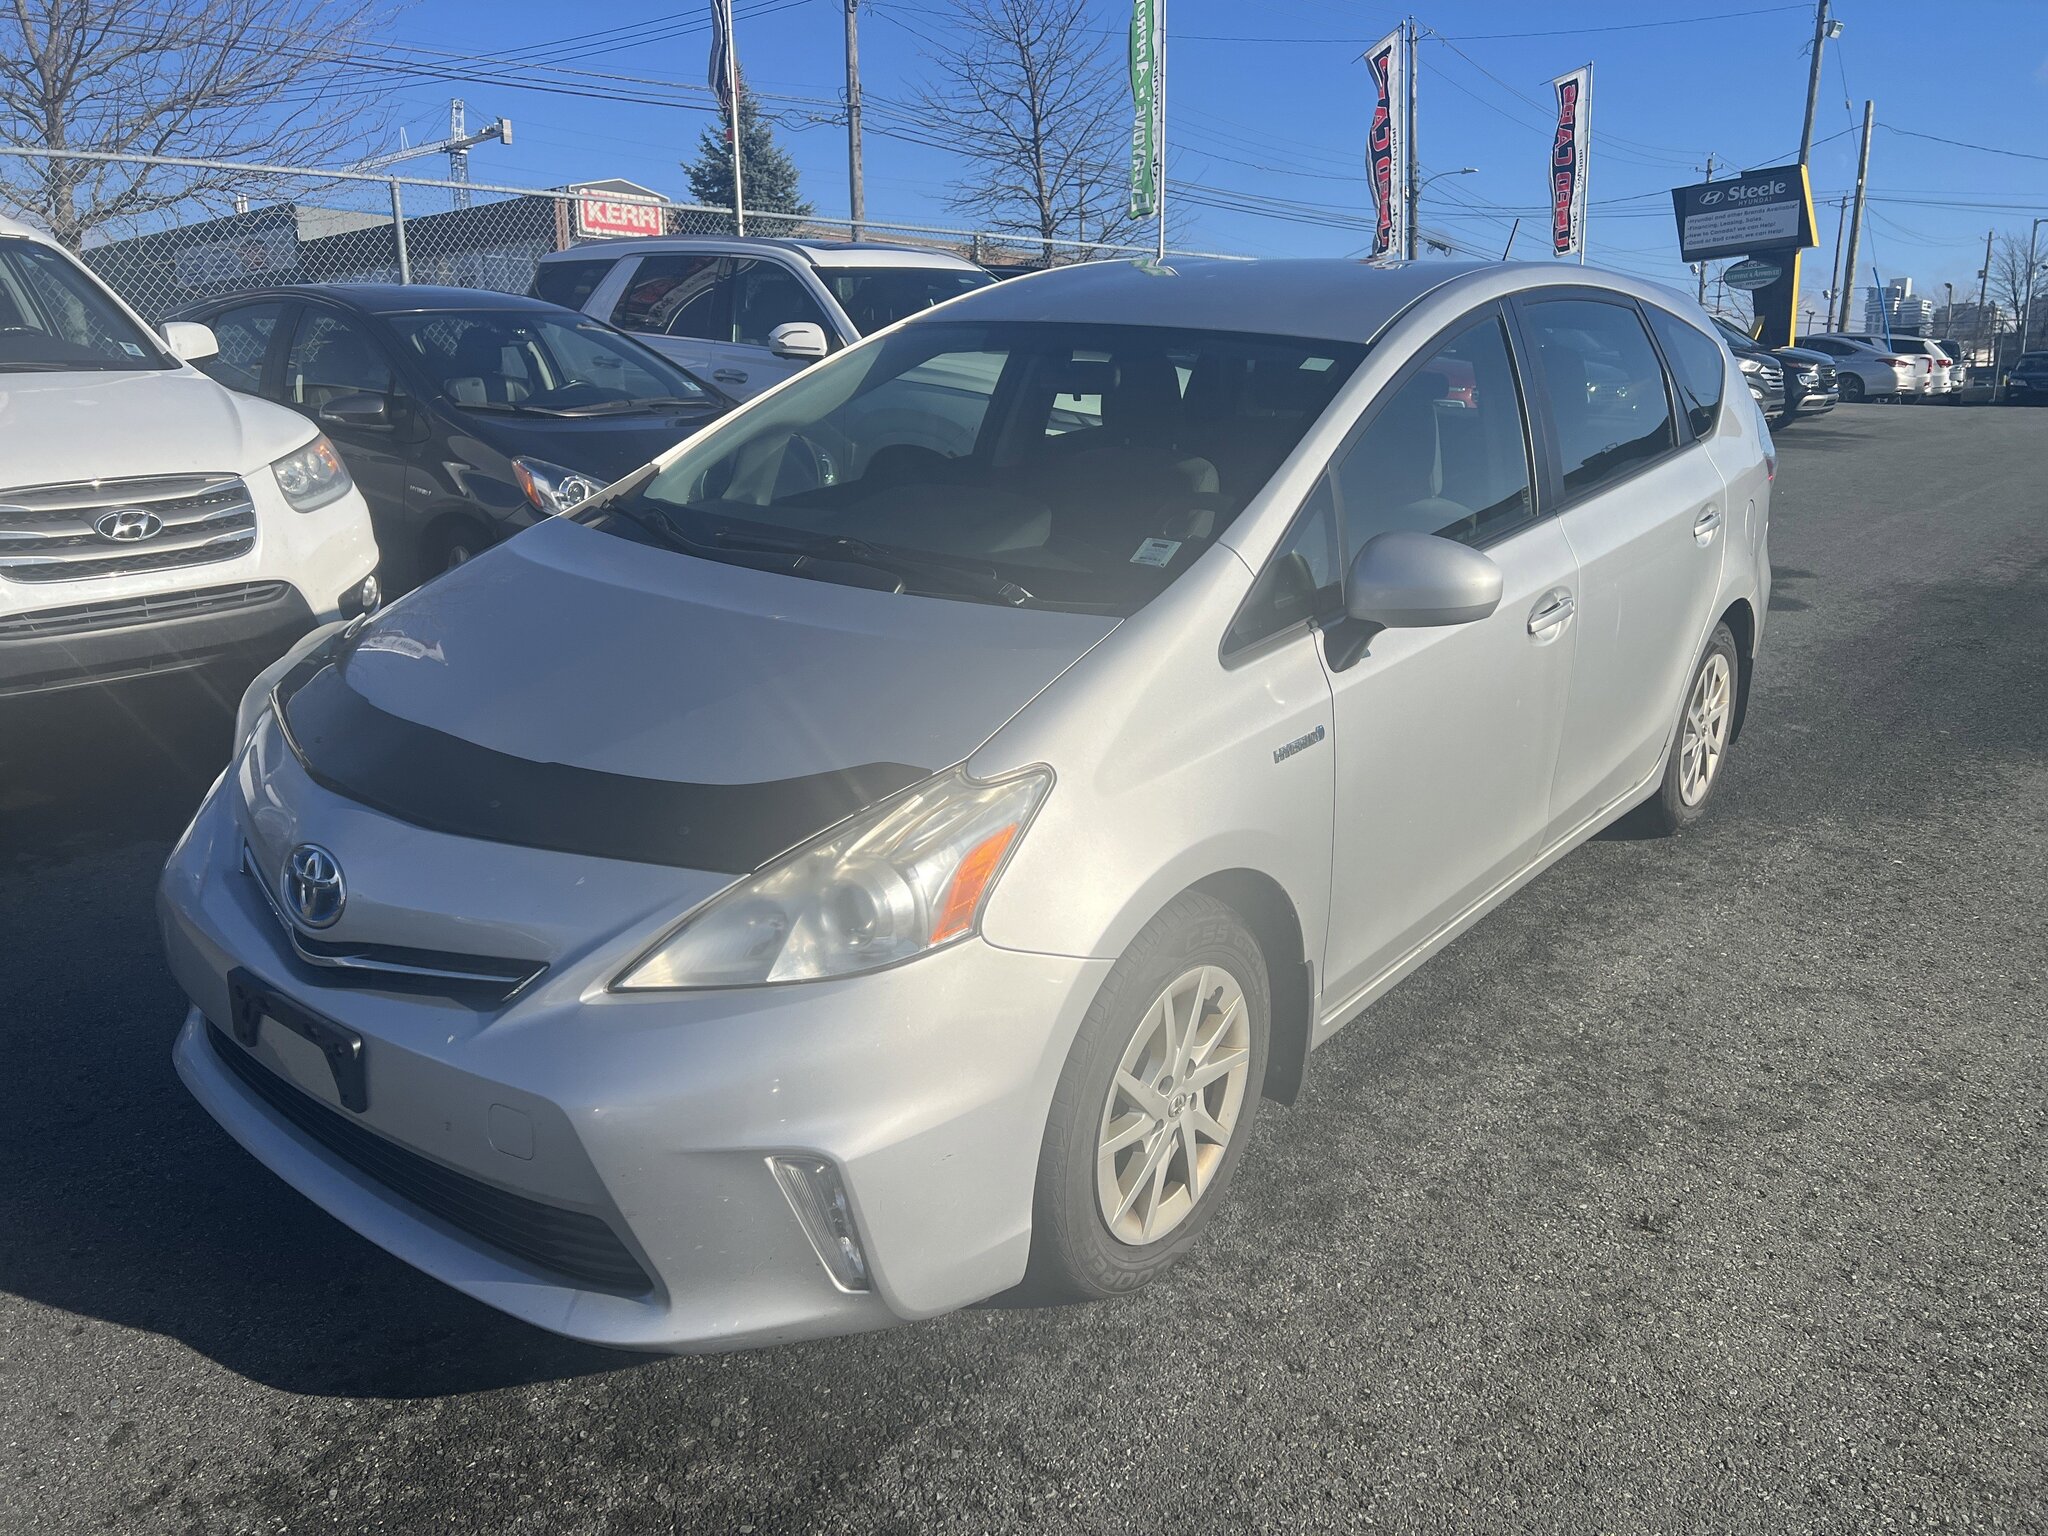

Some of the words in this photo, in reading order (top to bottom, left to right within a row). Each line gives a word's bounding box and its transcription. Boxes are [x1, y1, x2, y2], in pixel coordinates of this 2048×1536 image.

[1728, 180, 1787, 201] Steele
[1738, 196, 1772, 207] HYUNDAI
[587, 200, 657, 228] KERR
